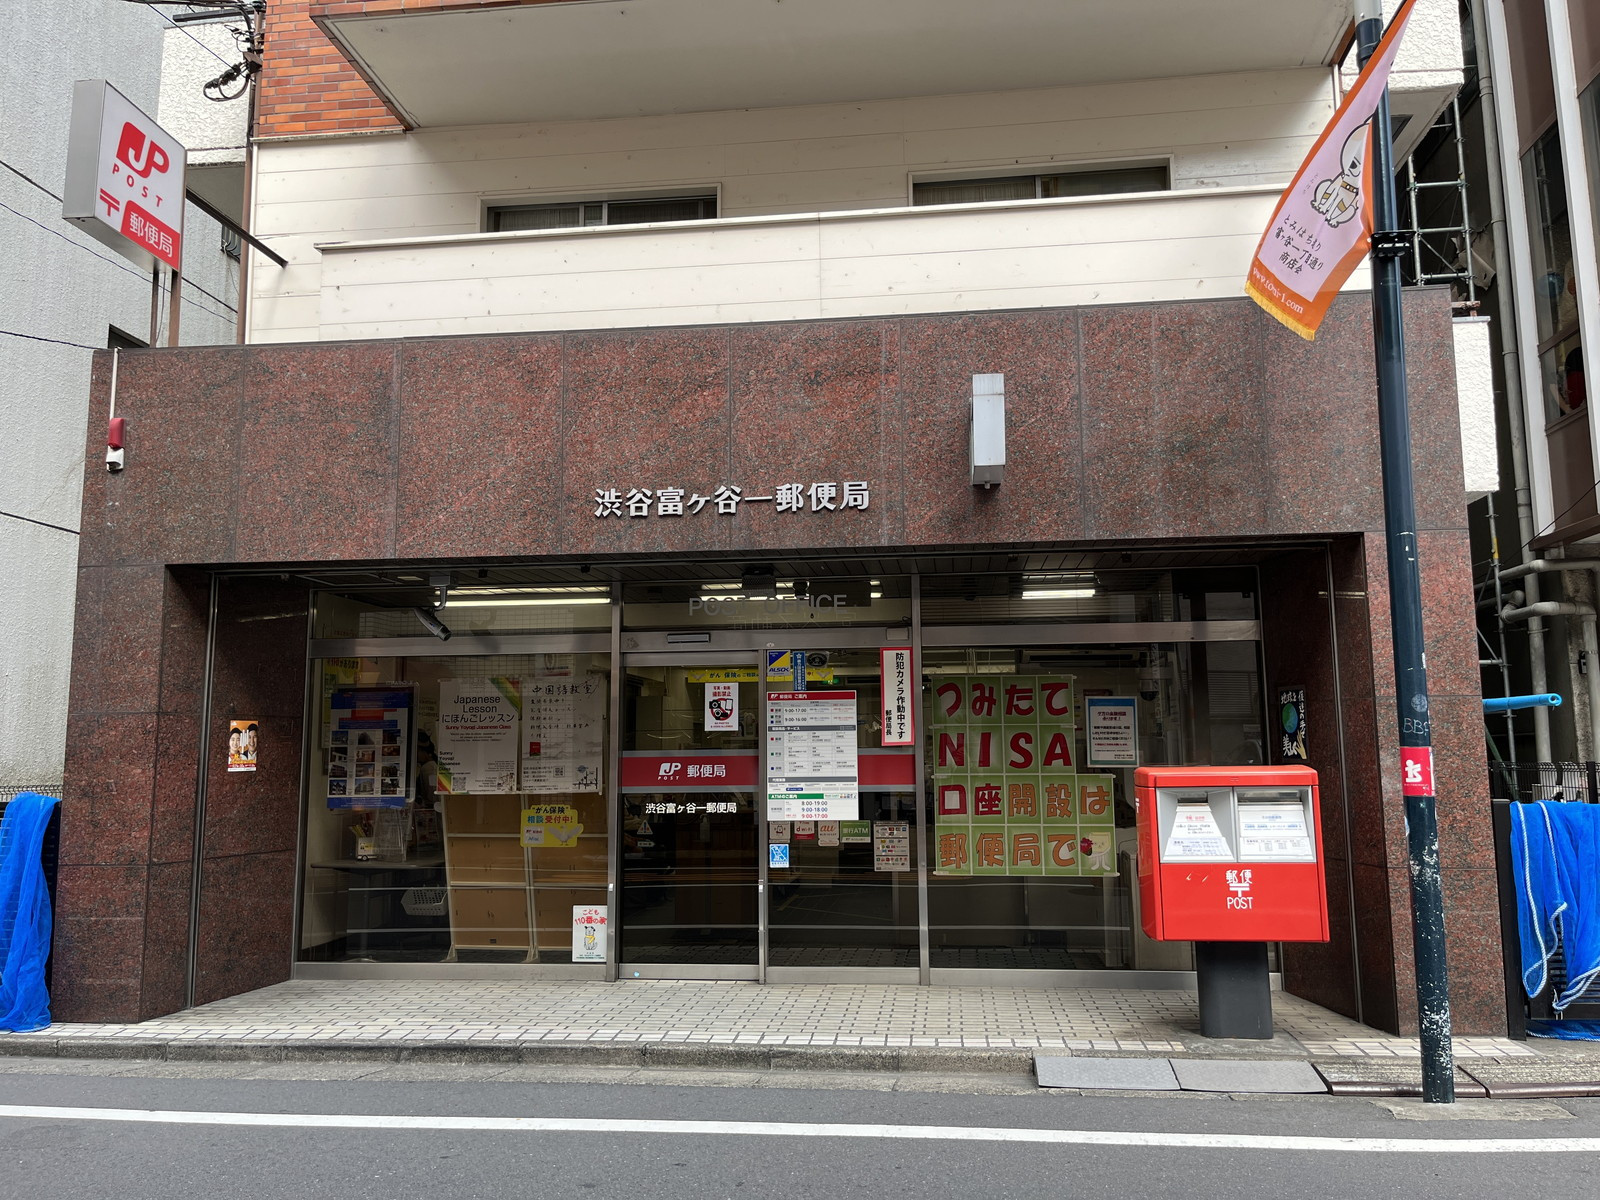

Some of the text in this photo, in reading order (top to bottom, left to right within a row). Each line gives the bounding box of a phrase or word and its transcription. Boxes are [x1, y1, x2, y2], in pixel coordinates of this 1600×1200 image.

[112, 164, 165, 208] POST
[128, 211, 174, 258] 郵便局
[1279, 251, 1303, 274] 商店会
[594, 480, 870, 518] 渋谷富ヶ谷一郵便局
[688, 594, 848, 616] POST OFFICE
[454, 695, 501, 705] Japanese
[532, 683, 592, 695] 中国語教室
[895, 652, 906, 739] 防犯カメラ作動中です
[936, 682, 1069, 717] つみたて
[441, 713, 515, 723] にほんごレッスン
[462, 705, 497, 713] Lesson
[885, 710, 893, 736] 郵便局長
[938, 731, 1072, 769] NISA
[686, 763, 726, 778] 郵便局
[645, 802, 737, 814] 渋谷富ヶ谷一郵便局
[938, 783, 1110, 818] 口座開設は
[939, 832, 1077, 869] 郵便局で
[1226, 869, 1253, 885] 郵便
[582, 908, 600, 916] こども
[1226, 897, 1253, 910] POST
